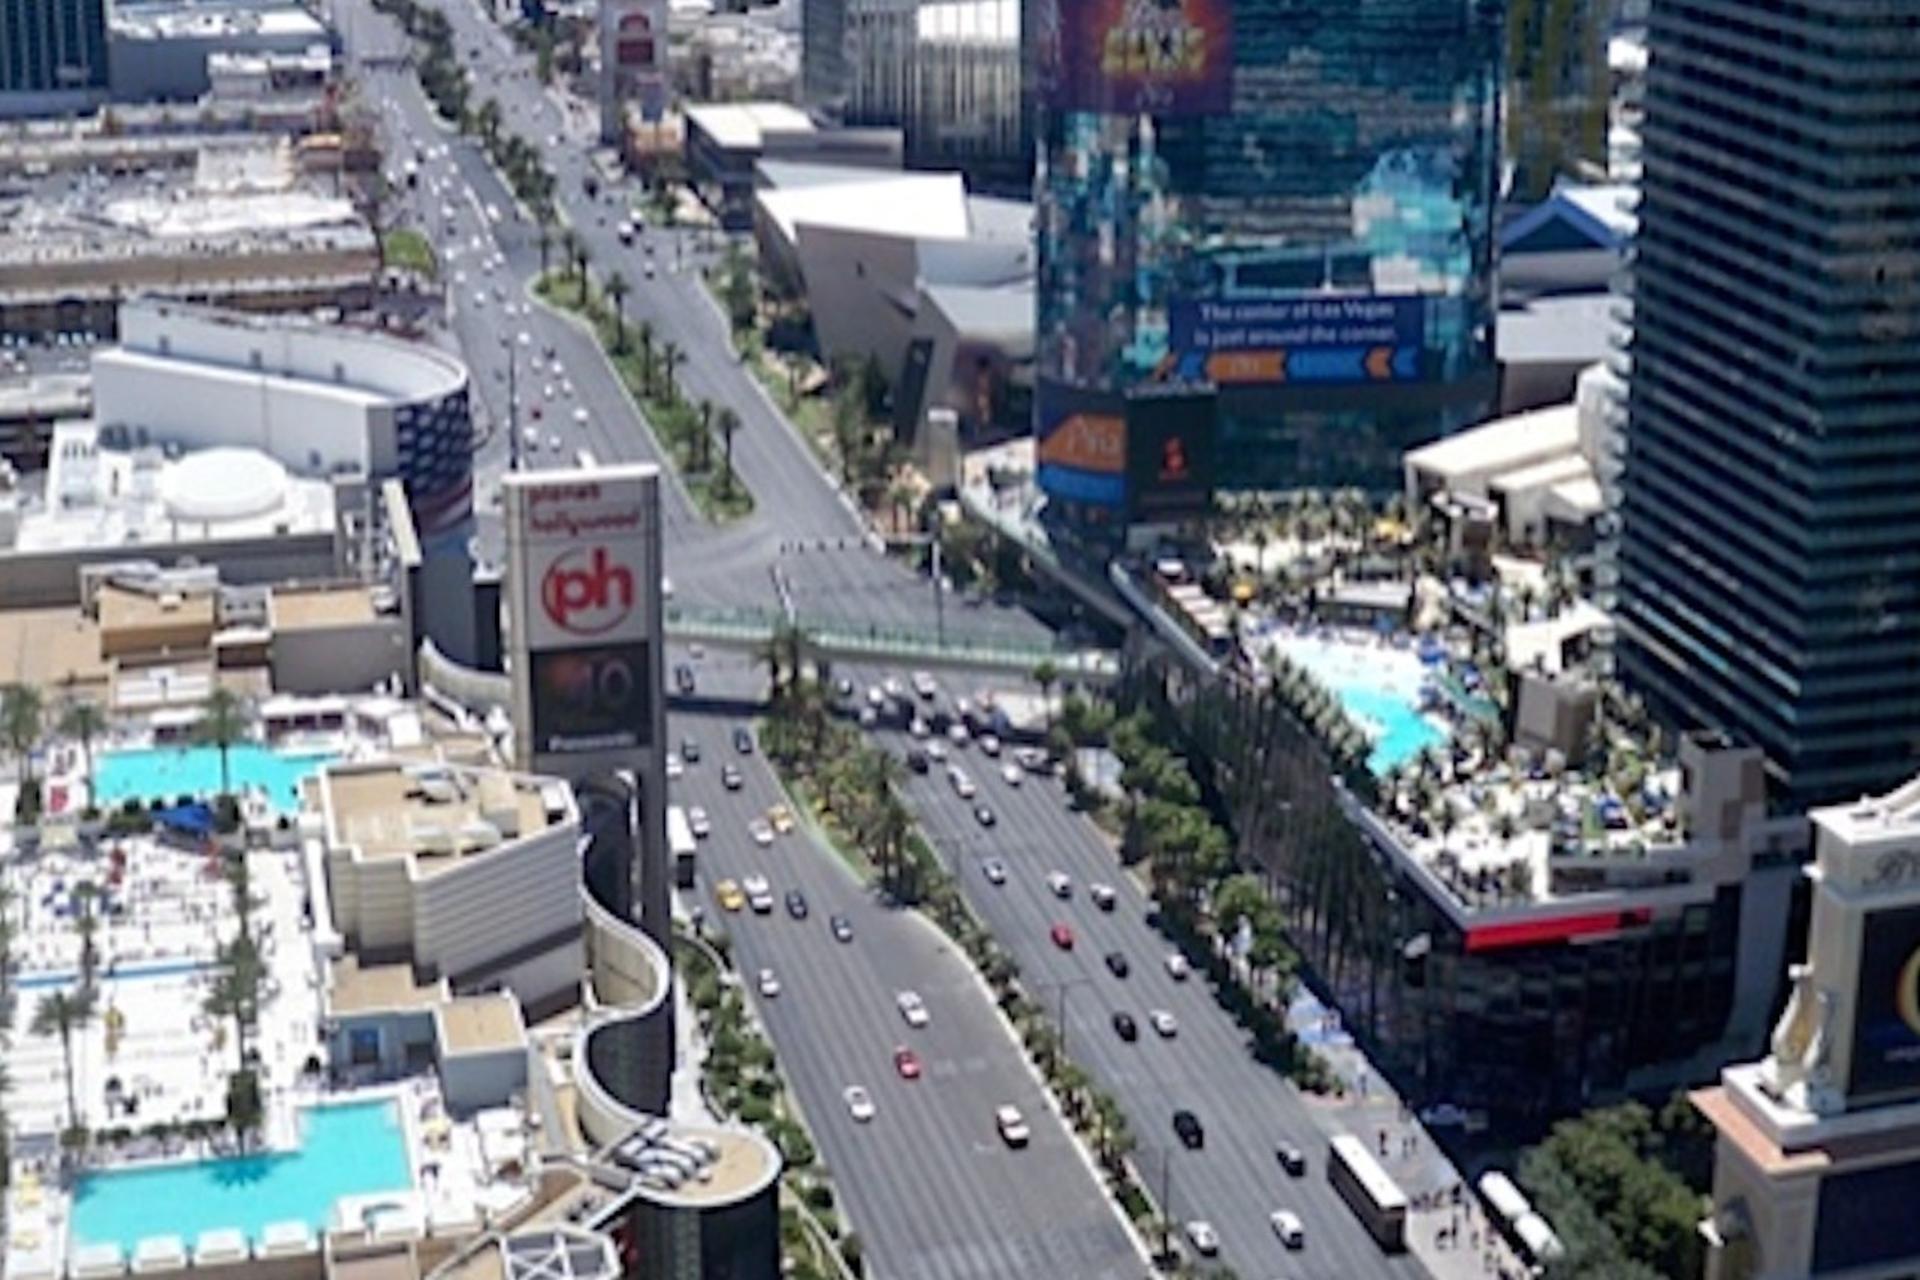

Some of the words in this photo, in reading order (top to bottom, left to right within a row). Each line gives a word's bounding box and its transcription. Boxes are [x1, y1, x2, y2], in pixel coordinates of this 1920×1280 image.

[1201, 304, 1229, 320] The
[1293, 302, 1309, 321] of
[1312, 302, 1341, 320] Las
[1344, 302, 1393, 322] Vegas
[1211, 325, 1244, 346] just
[1248, 325, 1307, 345] around
[1311, 324, 1337, 343] the
[529, 484, 599, 504] planet
[530, 509, 639, 536] hollywood
[553, 546, 634, 626] ph
